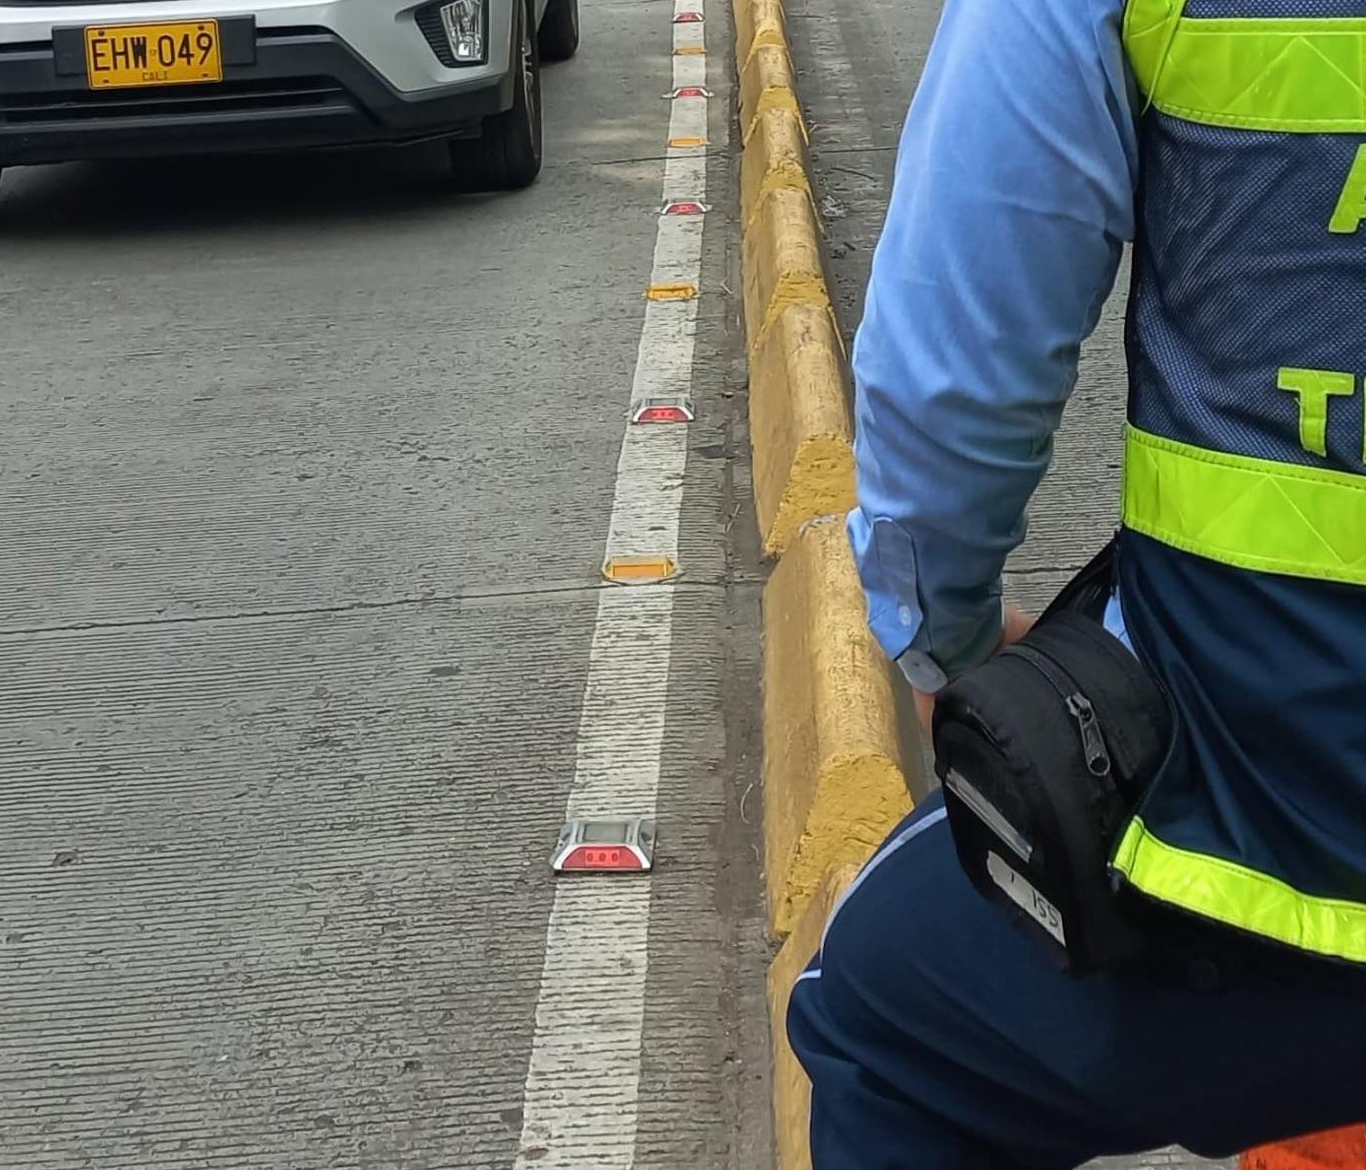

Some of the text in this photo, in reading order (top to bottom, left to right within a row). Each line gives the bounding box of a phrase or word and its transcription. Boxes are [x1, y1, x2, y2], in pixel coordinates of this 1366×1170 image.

[91, 32, 214, 72] EHW 049
[142, 71, 169, 82] CALI
